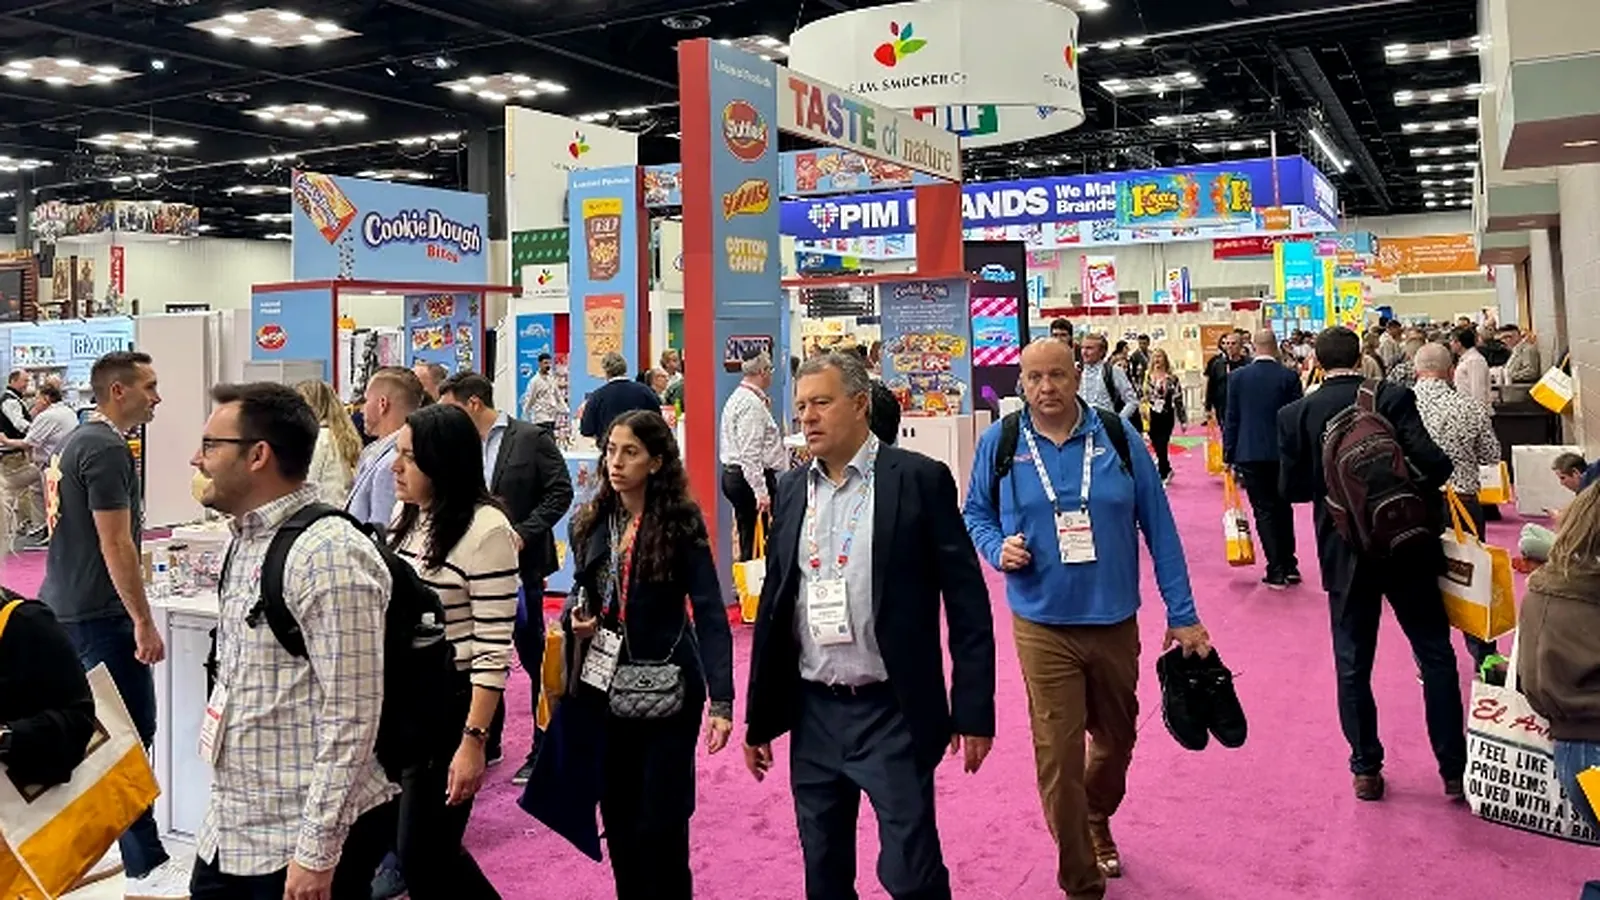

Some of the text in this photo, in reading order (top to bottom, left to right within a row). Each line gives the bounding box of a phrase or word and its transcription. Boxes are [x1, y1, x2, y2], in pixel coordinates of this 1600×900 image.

[882, 74, 948, 91] SMUCKER
[788, 76, 877, 149] TASTE
[882, 118, 898, 155] of
[903, 137, 952, 173] nature
[840, 200, 899, 230] PIM
[1056, 185, 1081, 199] We
[1087, 182, 1116, 198] Ma
[1056, 198, 1116, 214] Brands
[426, 244, 459, 263] Bites
[1472, 699, 1507, 724] El
[1470, 738, 1547, 775] I FEEL LIKE
[1471, 761, 1548, 794] PROBLEMS
[1469, 778, 1510, 803] OLVED
[1515, 791, 1550, 814] WITH
[1555, 804, 1563, 819] A
[1480, 802, 1561, 834] MARGARITA
